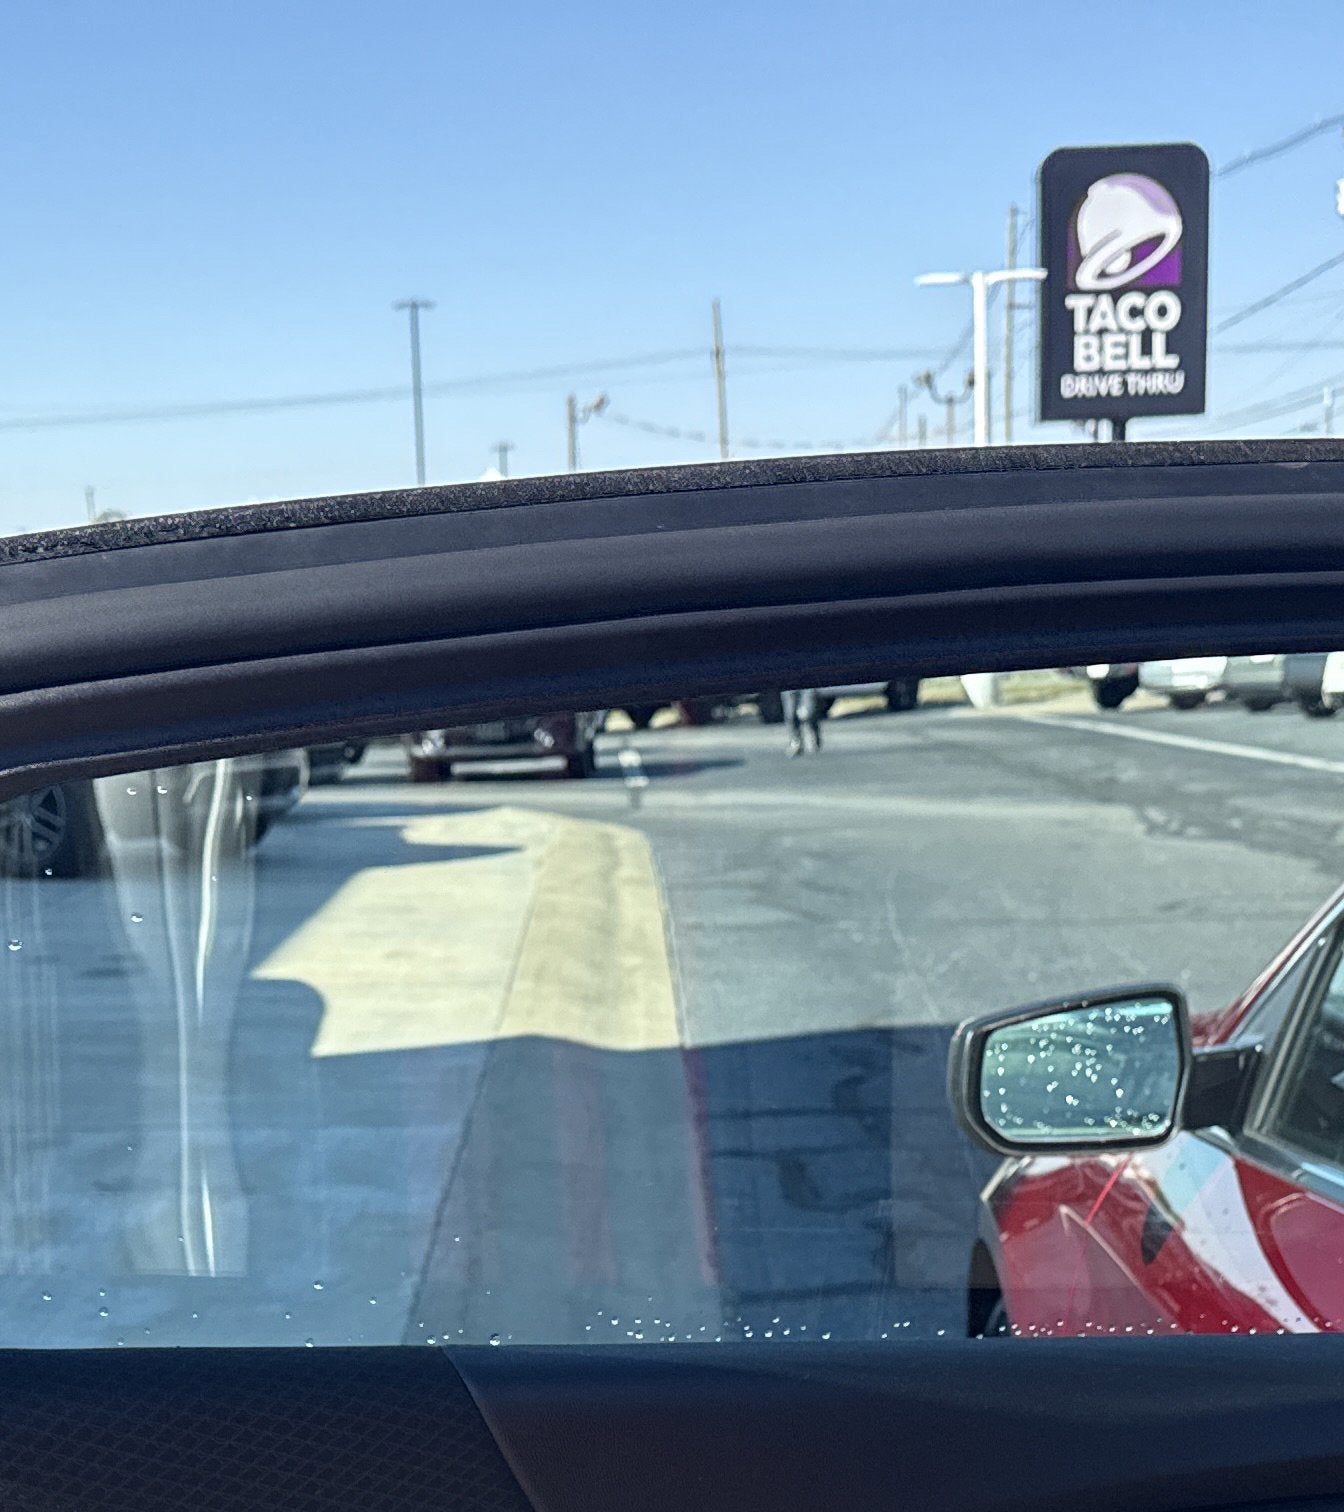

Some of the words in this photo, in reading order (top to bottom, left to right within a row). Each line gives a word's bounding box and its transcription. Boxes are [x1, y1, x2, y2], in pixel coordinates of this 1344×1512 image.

[1065, 290, 1182, 333] TACO
[1073, 331, 1180, 372] BELL
[1060, 373, 1124, 399] DRIVE
[1125, 370, 1185, 397] THRU
